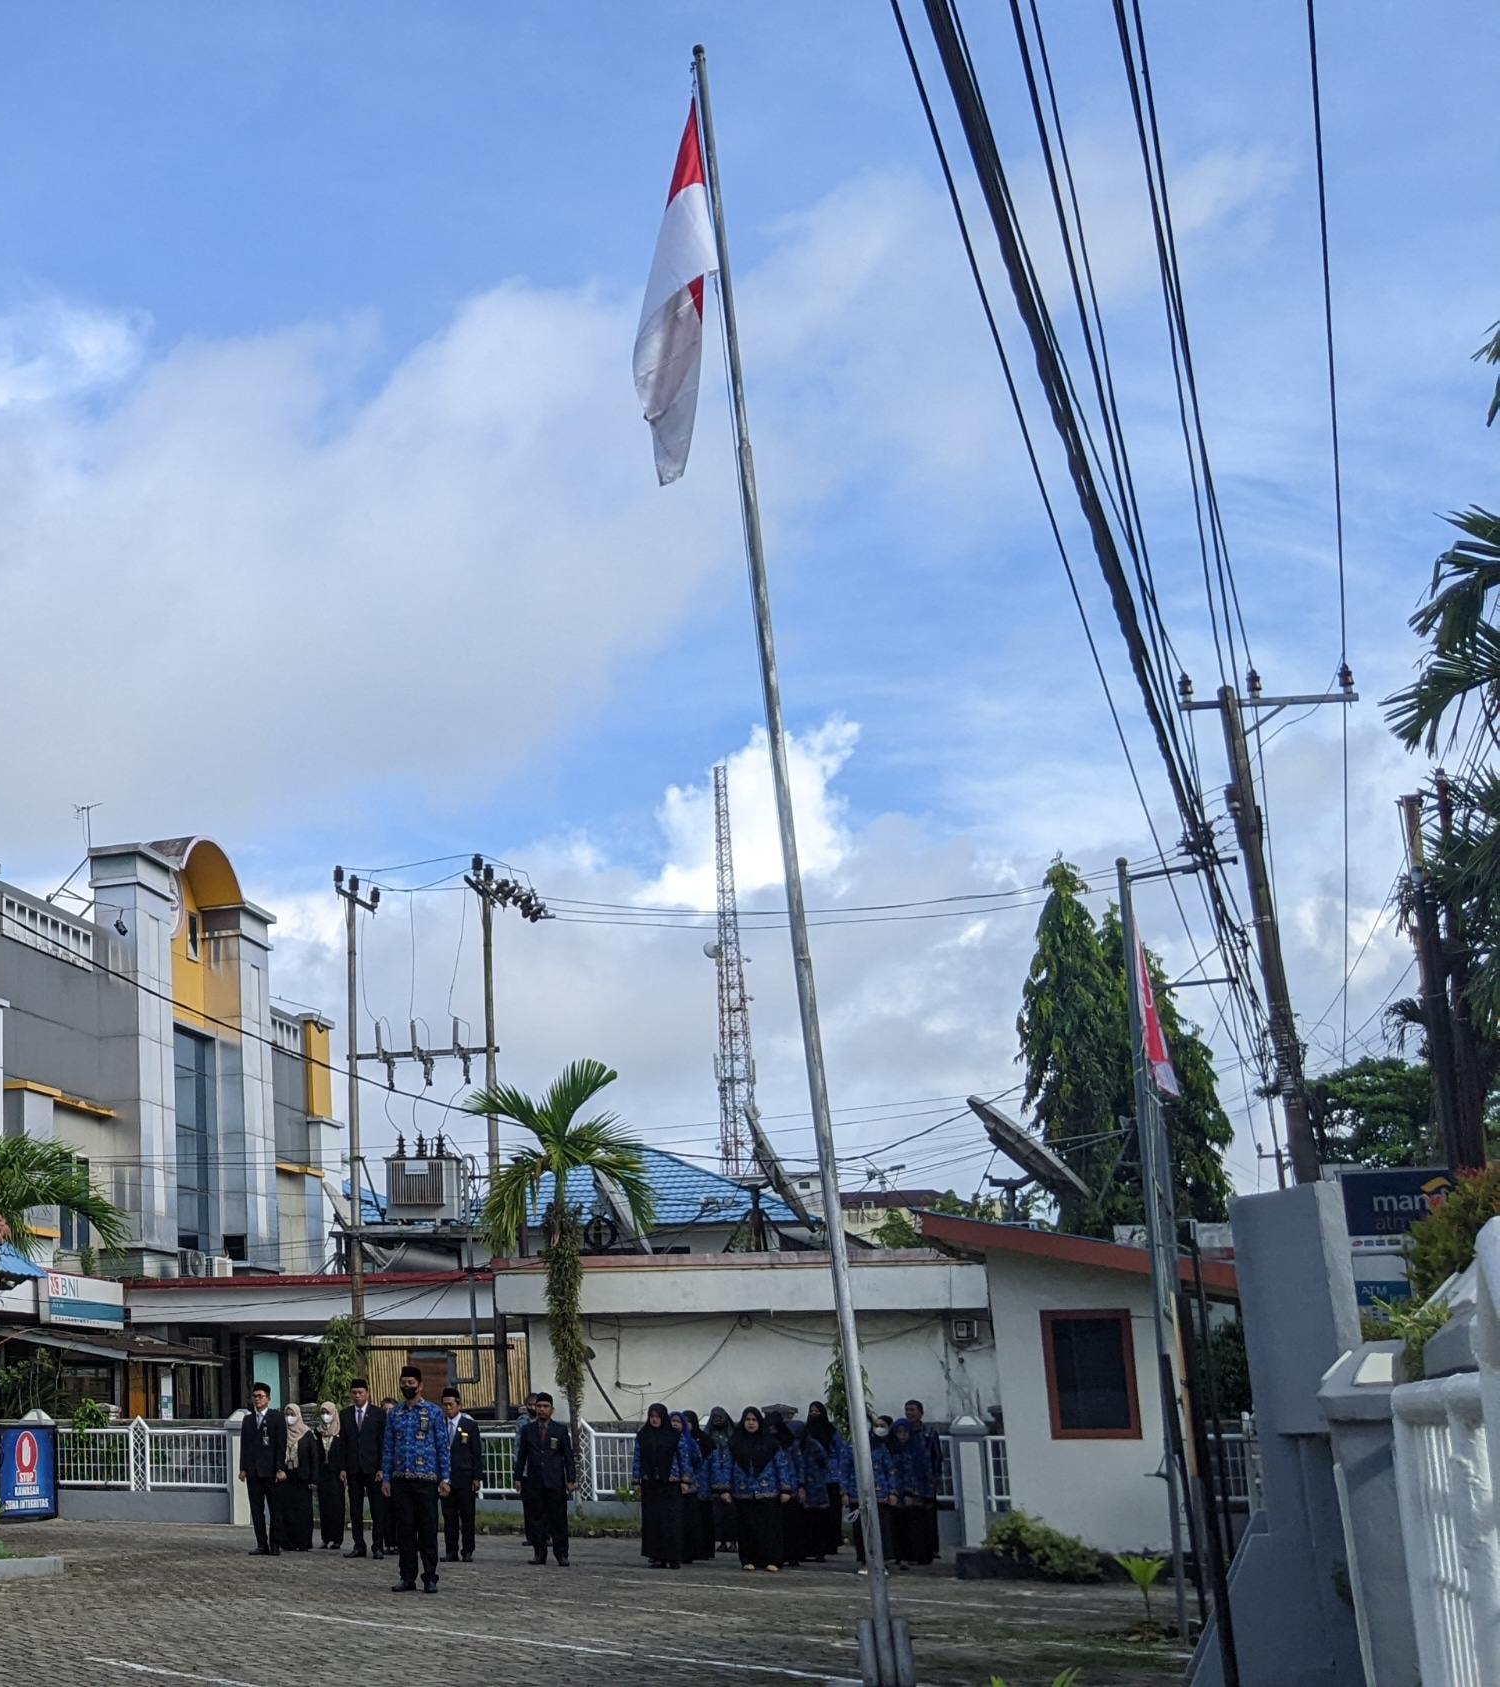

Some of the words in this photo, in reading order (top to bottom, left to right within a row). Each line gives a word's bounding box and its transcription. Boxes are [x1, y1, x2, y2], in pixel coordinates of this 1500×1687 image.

[62, 1277, 79, 1297] BNI
[1361, 1286, 1388, 1297] ATM
[19, 1472, 34, 1483] STOP
